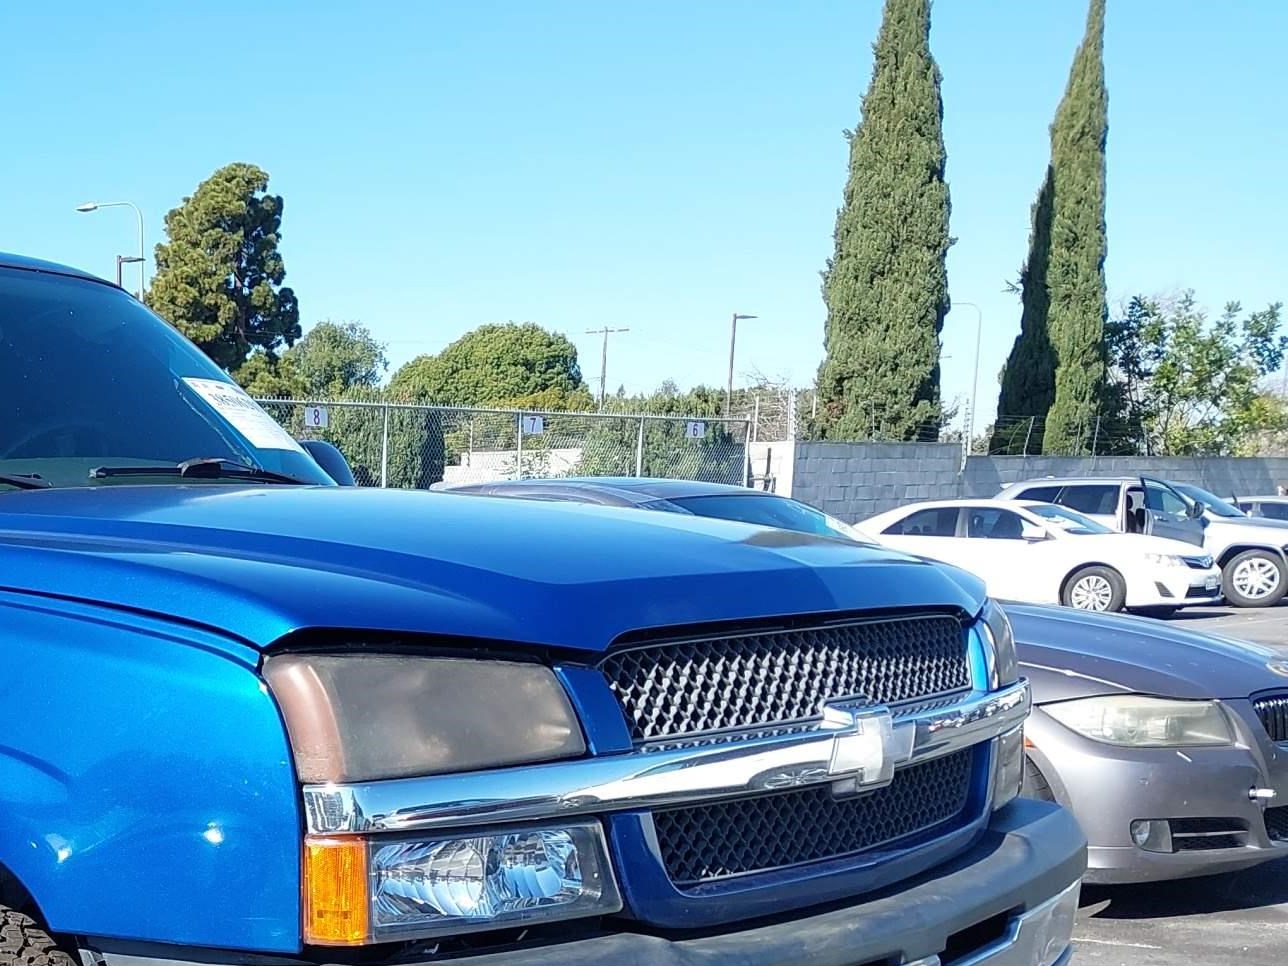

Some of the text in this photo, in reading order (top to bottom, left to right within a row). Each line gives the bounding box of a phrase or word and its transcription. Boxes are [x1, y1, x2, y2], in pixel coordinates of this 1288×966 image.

[313, 408, 320, 425] 8
[530, 417, 537, 433] 7
[692, 423, 699, 437] 6
